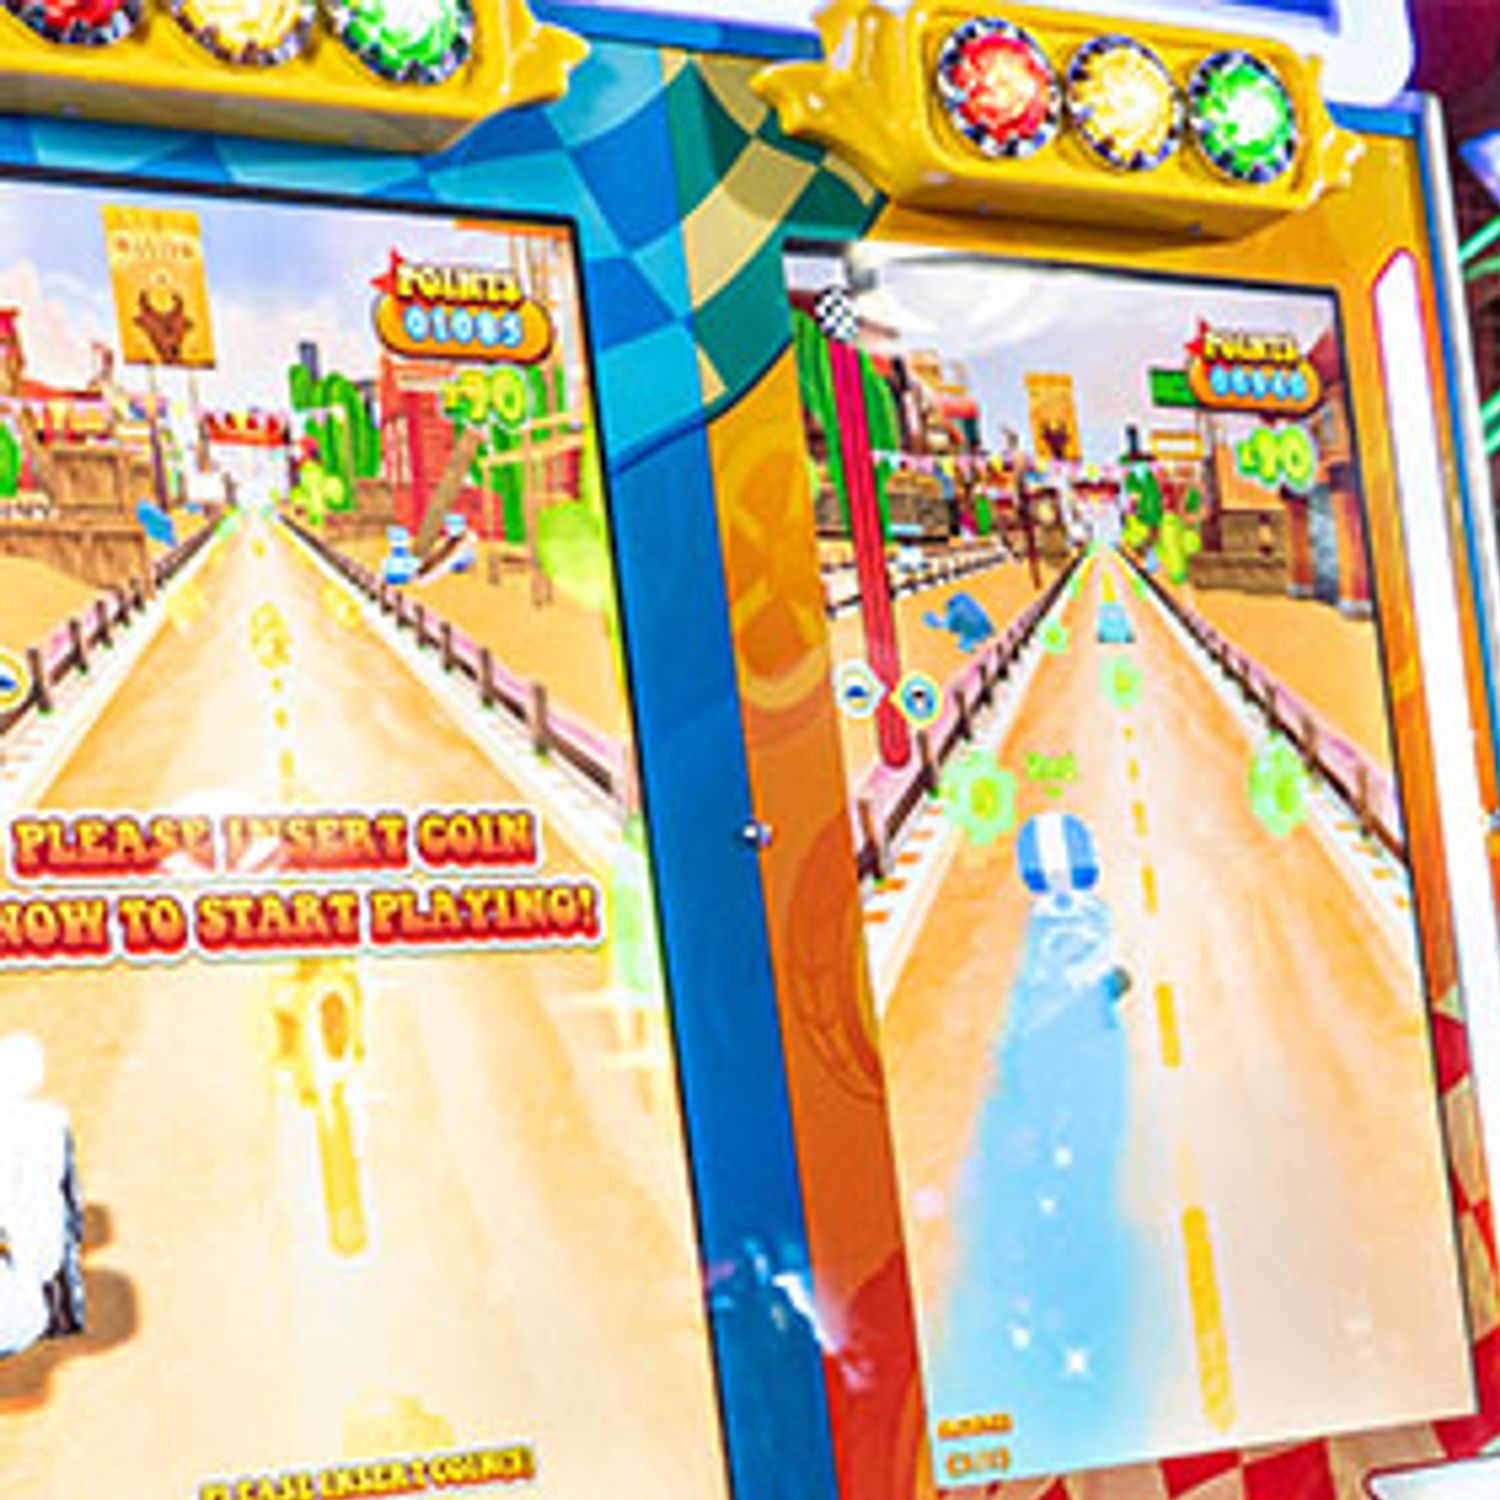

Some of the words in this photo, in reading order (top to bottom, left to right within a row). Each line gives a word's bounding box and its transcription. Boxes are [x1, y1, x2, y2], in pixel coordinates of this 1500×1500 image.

[11, 813, 213, 877] PLEASE
[224, 813, 409, 874] INSERT
[416, 811, 538, 867] COIN
[0, 898, 110, 960] NOW
[117, 894, 187, 954] TO
[195, 888, 362, 950] START
[369, 883, 602, 946] PLAYING!
